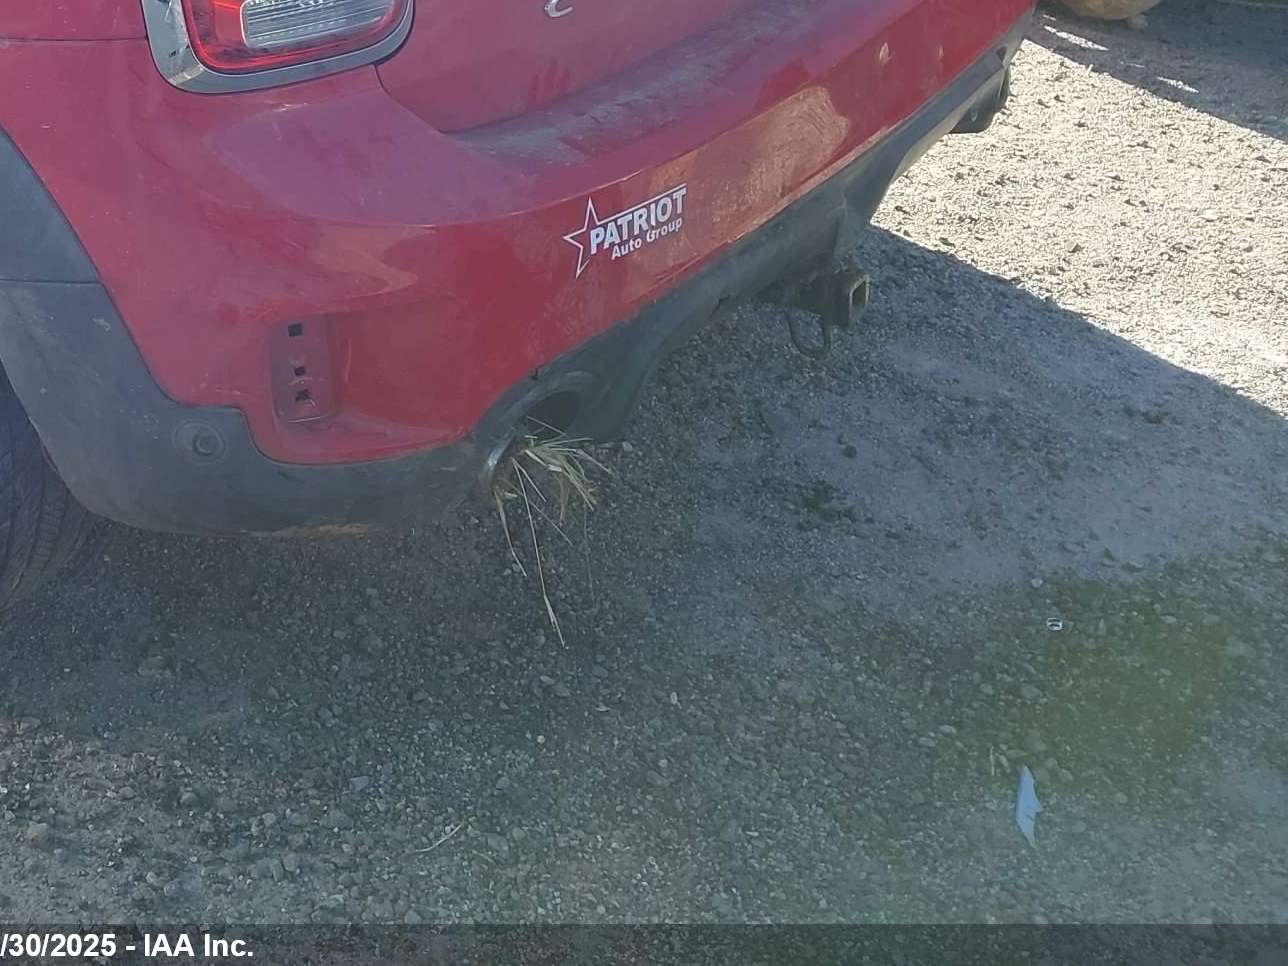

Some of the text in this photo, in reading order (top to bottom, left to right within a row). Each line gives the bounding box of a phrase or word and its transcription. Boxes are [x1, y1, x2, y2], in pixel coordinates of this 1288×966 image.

[589, 187, 687, 255] PATRIOT
[611, 217, 683, 261] Auto Group
